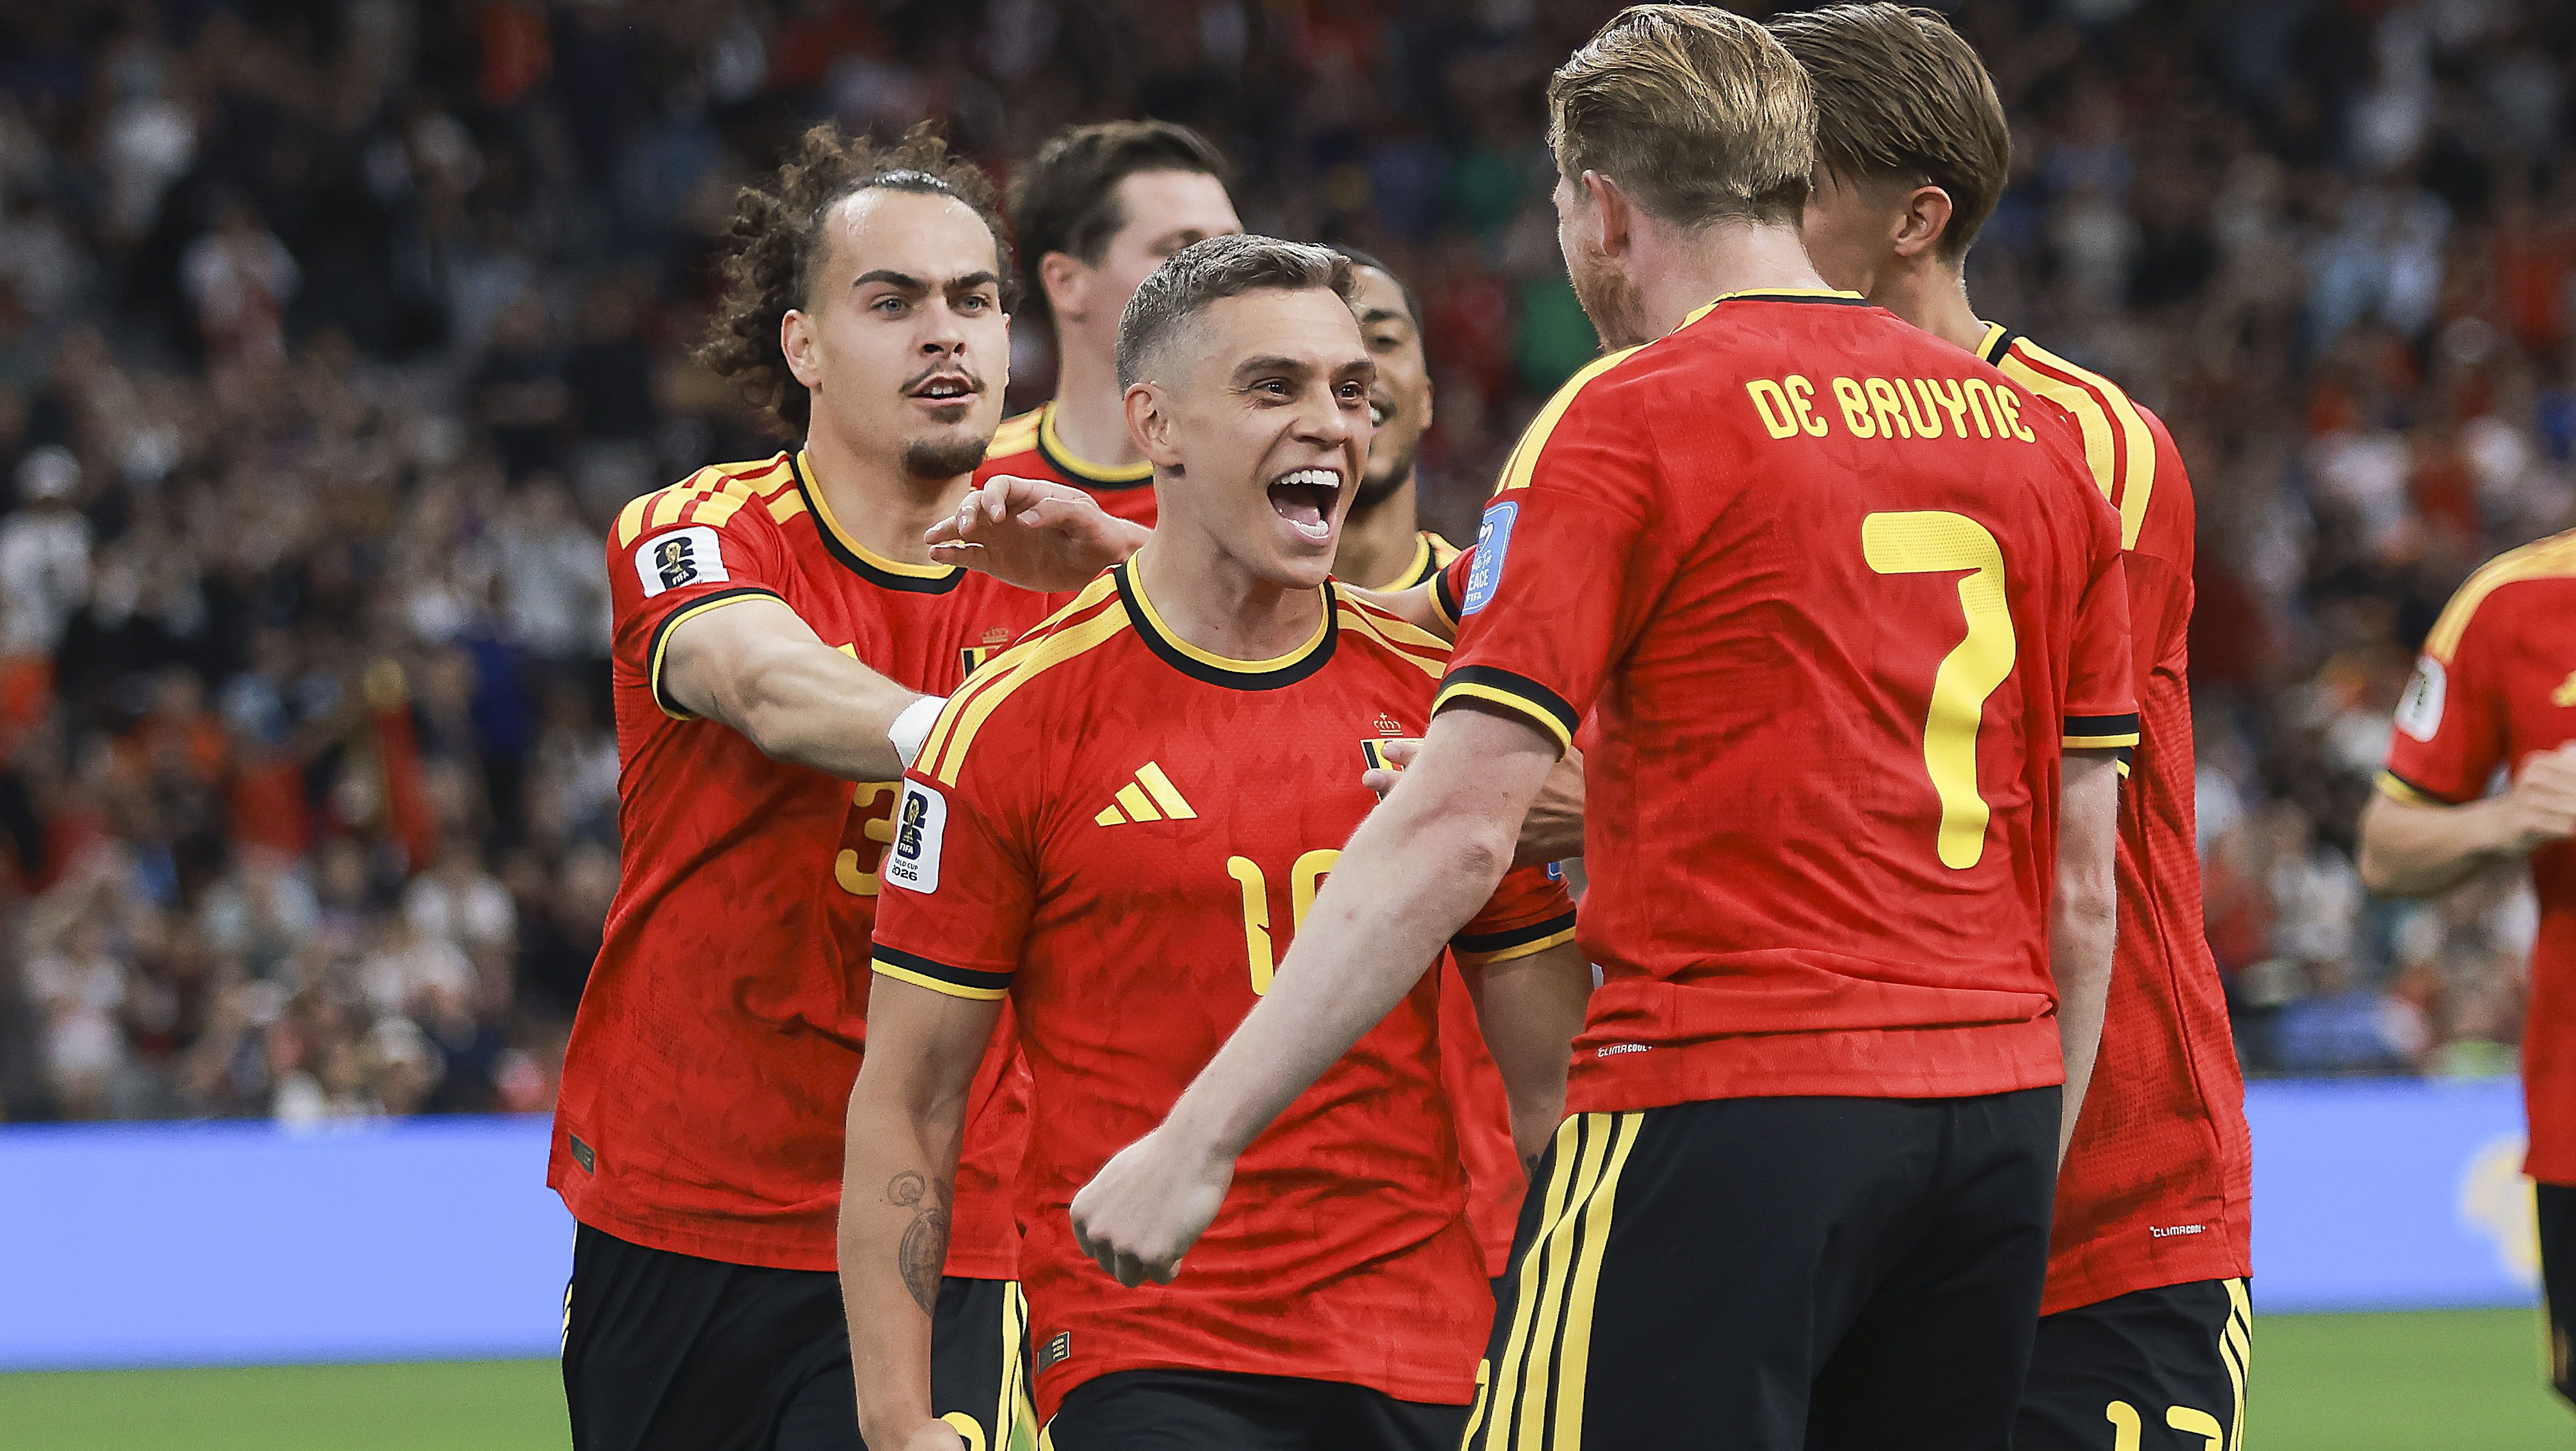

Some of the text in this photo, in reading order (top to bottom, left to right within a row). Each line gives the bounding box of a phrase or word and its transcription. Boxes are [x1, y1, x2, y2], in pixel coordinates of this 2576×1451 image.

[1746, 375, 2036, 443] DE BRUYNE
[1467, 591, 1482, 602] FIFA
[1468, 568, 1490, 591] EACE
[1861, 511, 2016, 869] 7
[835, 781, 903, 895] 3
[899, 842, 913, 854] FIFA
